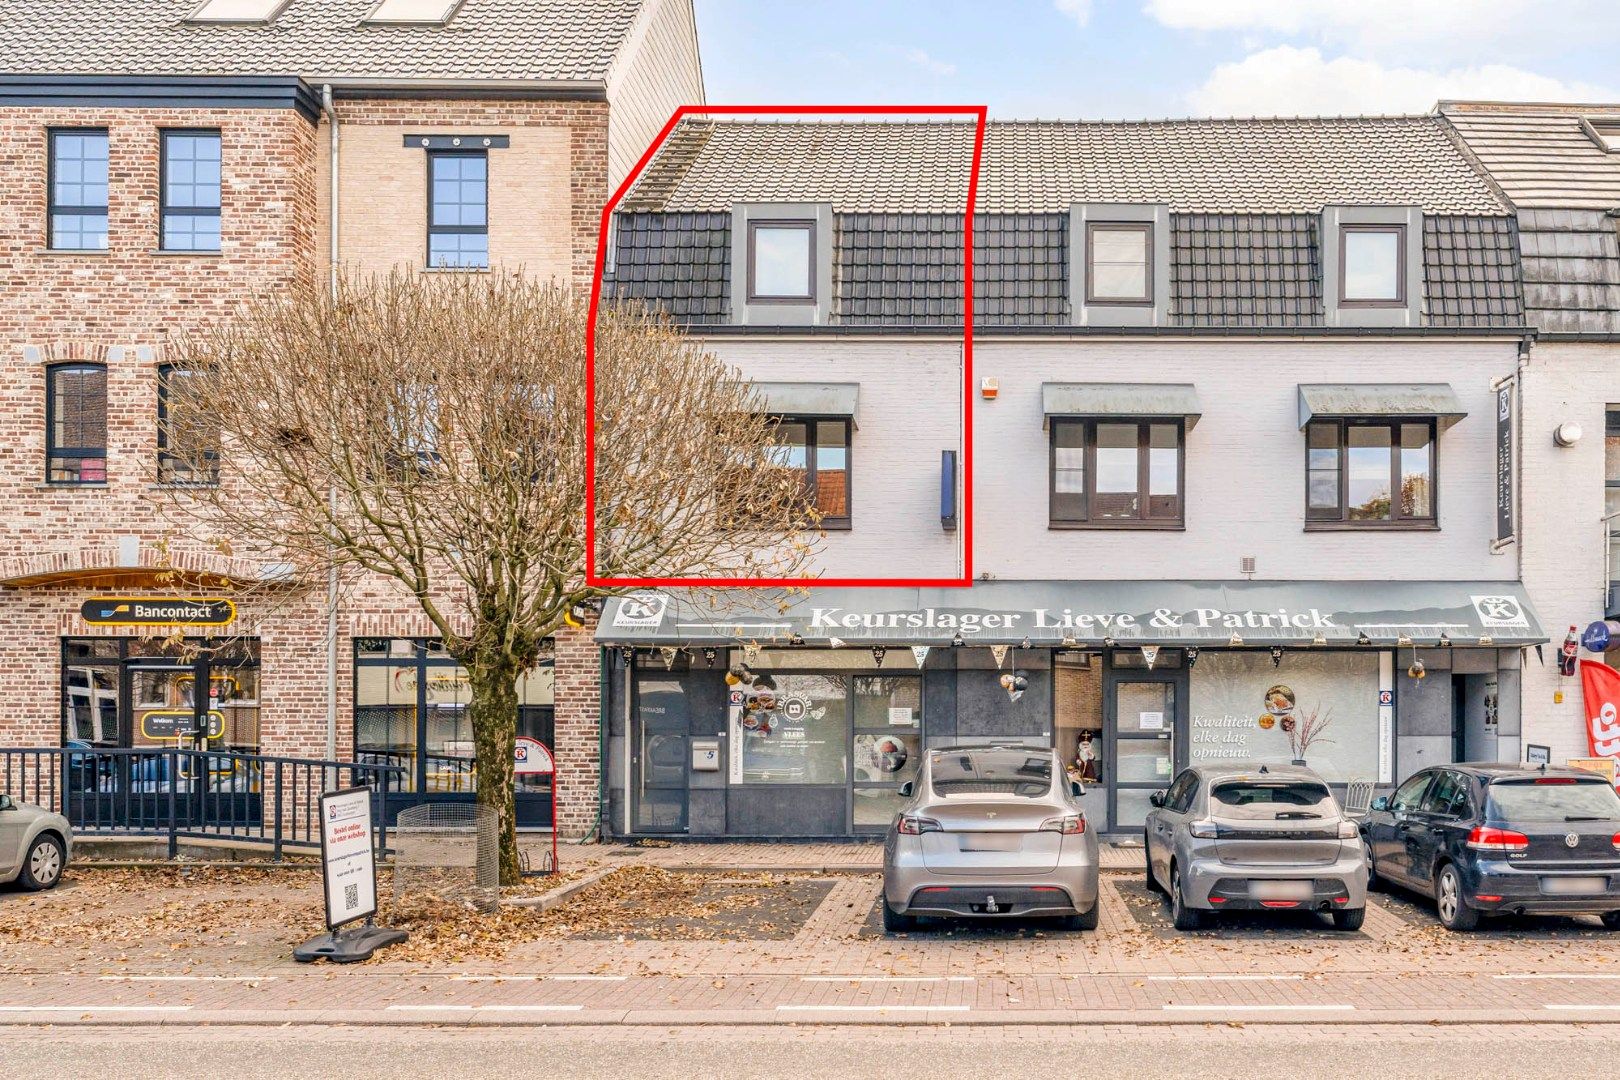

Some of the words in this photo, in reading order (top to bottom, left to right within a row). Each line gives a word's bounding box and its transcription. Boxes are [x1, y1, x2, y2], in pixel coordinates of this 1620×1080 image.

[1503, 475, 1510, 486] &
[135, 605, 211, 618] Bancontact
[810, 608, 1021, 633] Keurslager
[1032, 608, 1136, 629] Lieve
[1149, 608, 1184, 628] &
[1193, 608, 1339, 629] Patrick
[705, 651, 715, 659] 25
[1193, 715, 1256, 728] Kwaliteit,
[1193, 731, 1219, 743] elke
[1222, 731, 1247, 745] dag
[706, 751, 714, 759] 5
[1193, 745, 1251, 760] opnieuw.
